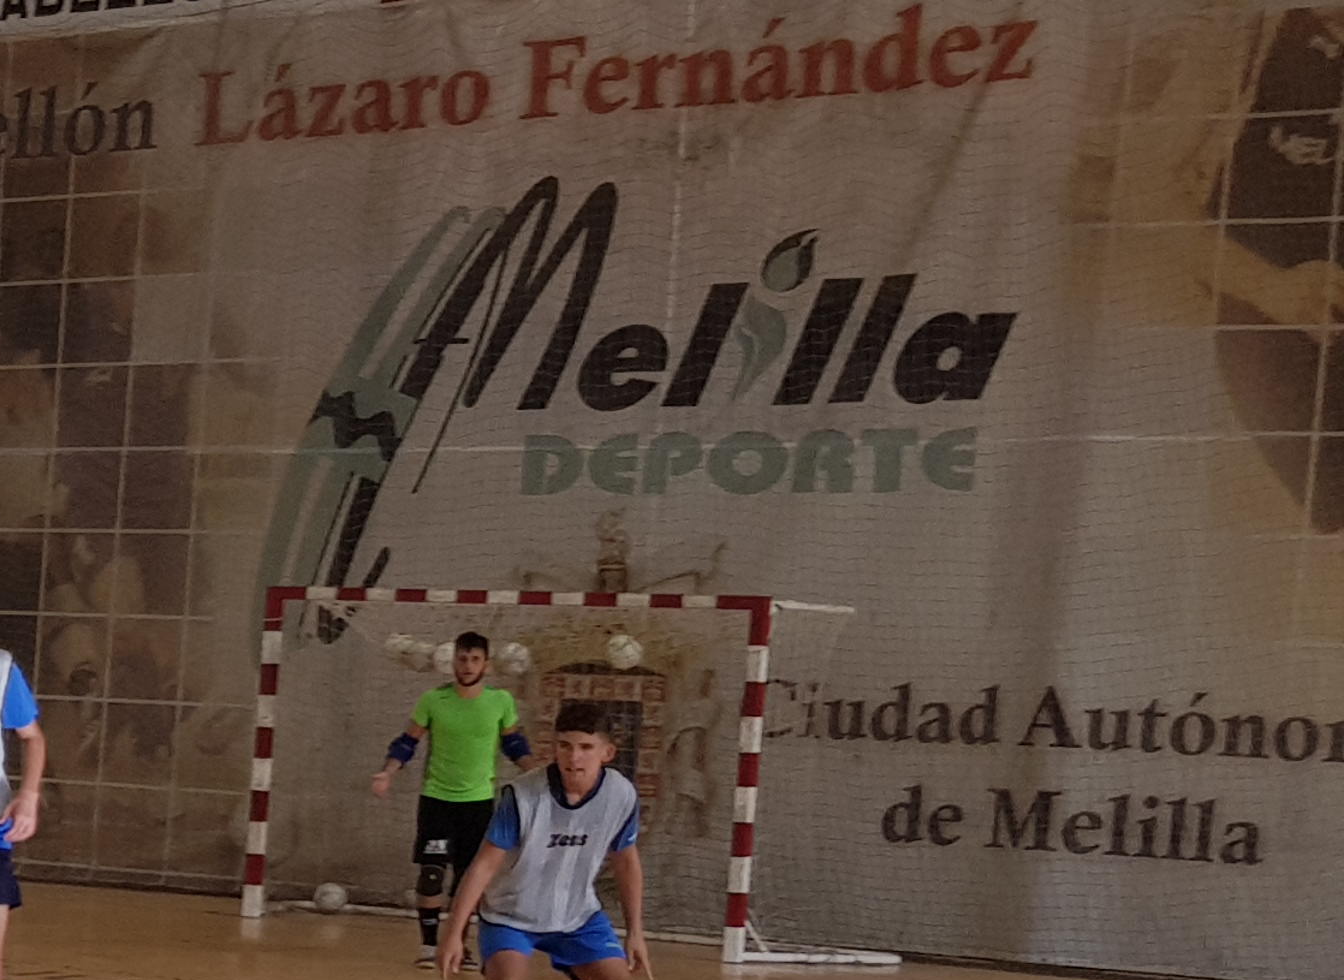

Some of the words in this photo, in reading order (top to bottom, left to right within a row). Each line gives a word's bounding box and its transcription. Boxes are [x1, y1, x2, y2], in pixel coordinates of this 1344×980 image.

[193, 63, 491, 146] Lázaro
[518, 9, 1040, 121] Fernández
[392, 175, 1018, 413] Melilla
[519, 426, 979, 497] DEPORTE
[880, 785, 964, 848] de
[984, 786, 1264, 865] Melilla
